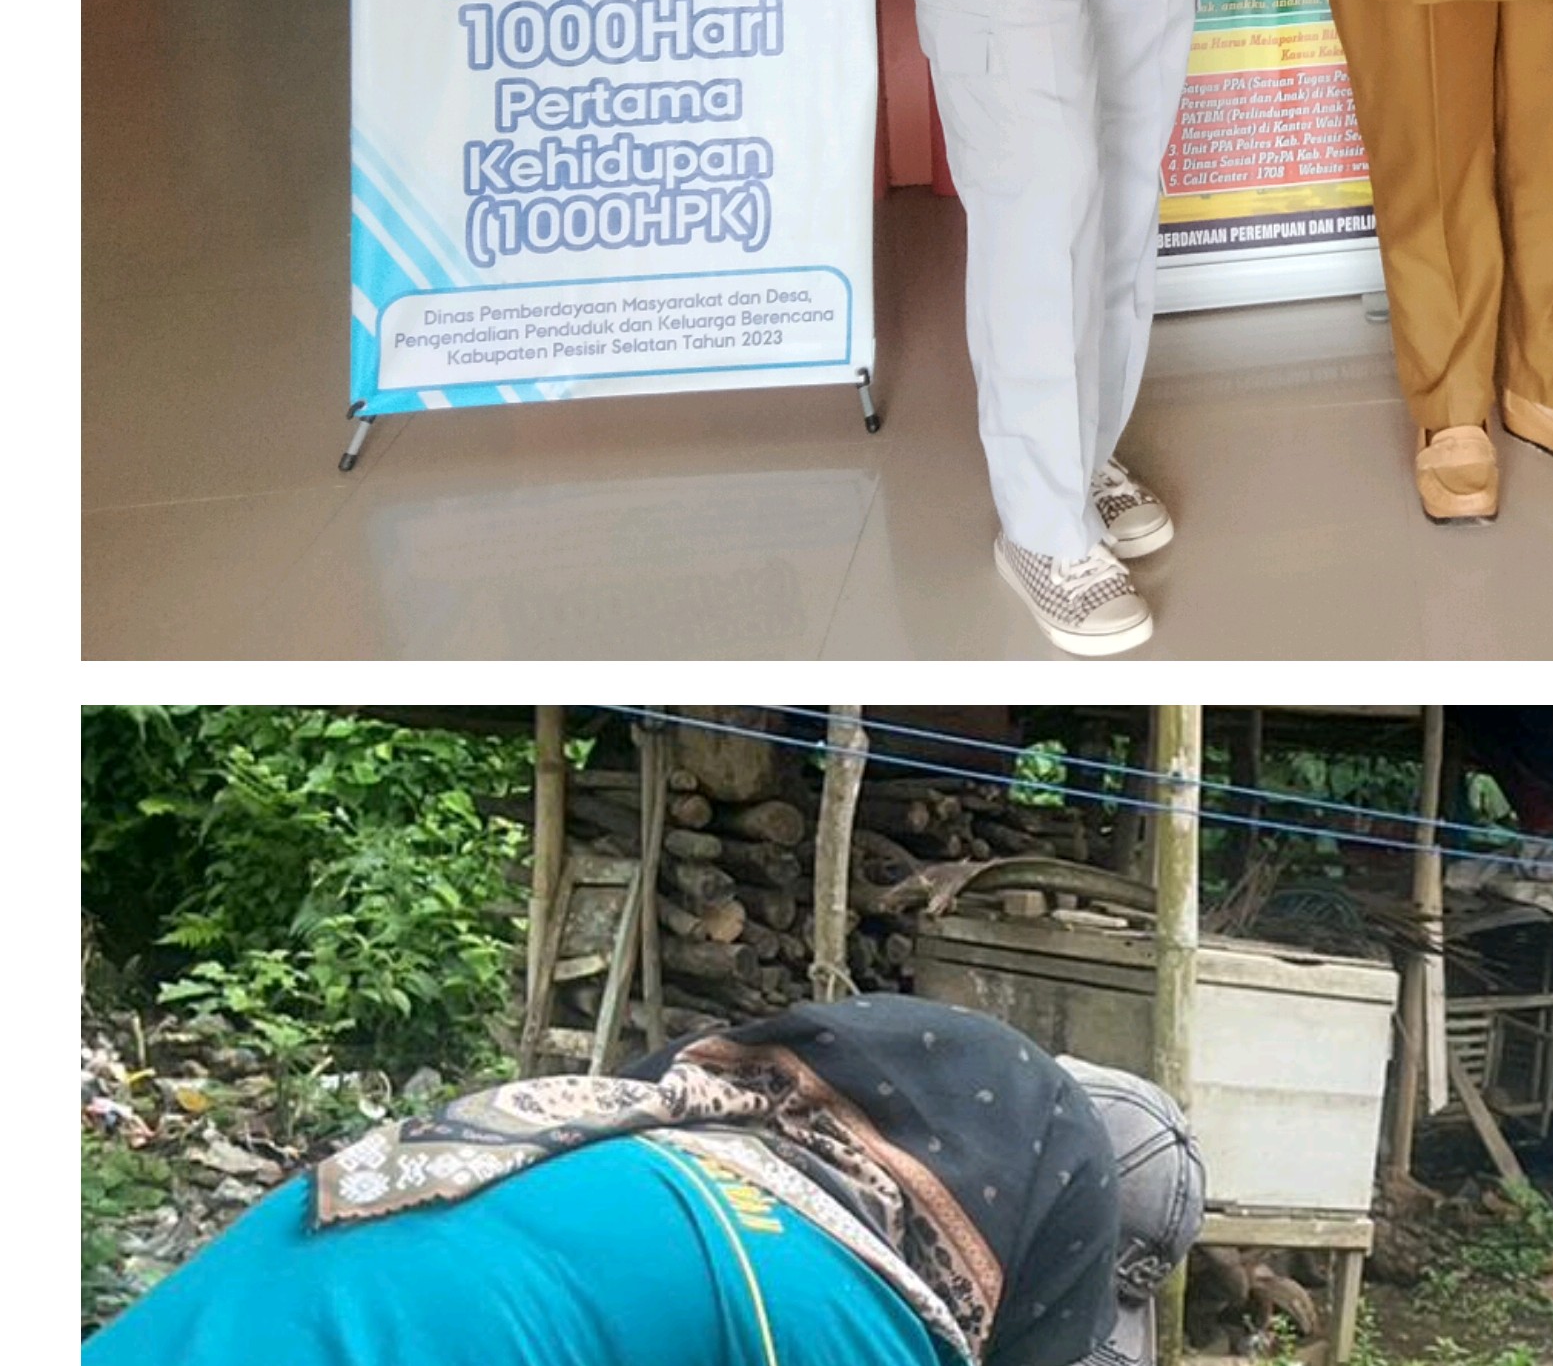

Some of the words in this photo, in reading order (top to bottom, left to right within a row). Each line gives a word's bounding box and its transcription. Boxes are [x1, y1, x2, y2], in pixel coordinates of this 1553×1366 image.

[1249, 32, 1319, 50] Melaporkan
[1281, 47, 1316, 61] Kasus
[1223, 78, 1246, 92] PPA
[1248, 76, 1294, 91] (Satuan
[1298, 72, 1331, 86] Tugas
[495, 78, 743, 132] Pertama
[1180, 94, 1248, 111] Perempuan
[1249, 92, 1273, 103] dan
[1274, 88, 1310, 103] Anak)
[1312, 88, 1325, 99] di
[1181, 111, 1224, 126] PATBM
[1227, 105, 1310, 124] (Perlindungan
[1312, 101, 1342, 114] Anak
[1181, 125, 1256, 142] Masyarakat)
[1258, 125, 1270, 136] di
[1273, 121, 1313, 134] Kantor
[1315, 116, 1342, 129] Wali
[1182, 142, 1208, 156] Unit
[1210, 139, 1233, 153] PPA
[1236, 137, 1272, 151] Polres
[1274, 133, 1299, 147] Kab.
[1303, 131, 1343, 145] Pesisir
[463, 136, 774, 196] Kehidupan
[1182, 156, 1218, 171] Dinas
[1220, 152, 1256, 167] Sosial
[1297, 147, 1323, 161] Kab.
[1325, 145, 1365, 159] Pesisir
[1182, 172, 1208, 185] Call
[1209, 169, 1249, 184] Center
[1299, 161, 1344, 176] Website
[466, 180, 771, 267] (1000HPK)
[1230, 220, 1306, 243] PEREMPUAN
[1309, 217, 1334, 234] DAN
[424, 308, 475, 325] Dinas
[480, 299, 617, 322] Pemberdayaan
[622, 292, 723, 315] Masyarakat
[727, 290, 762, 307] dan
[766, 288, 813, 306] Desa,
[394, 326, 519, 351] Pengendalian
[524, 318, 614, 340] Penduduk
[618, 317, 653, 334] dan
[658, 311, 736, 333] Keluarga
[741, 307, 835, 327] Berencana
[447, 343, 549, 367] Kabupaten
[552, 339, 607, 359] Pesisir
[612, 336, 678, 354] Selatan
[682, 333, 736, 351] Tahun
[741, 329, 784, 348] 2023
